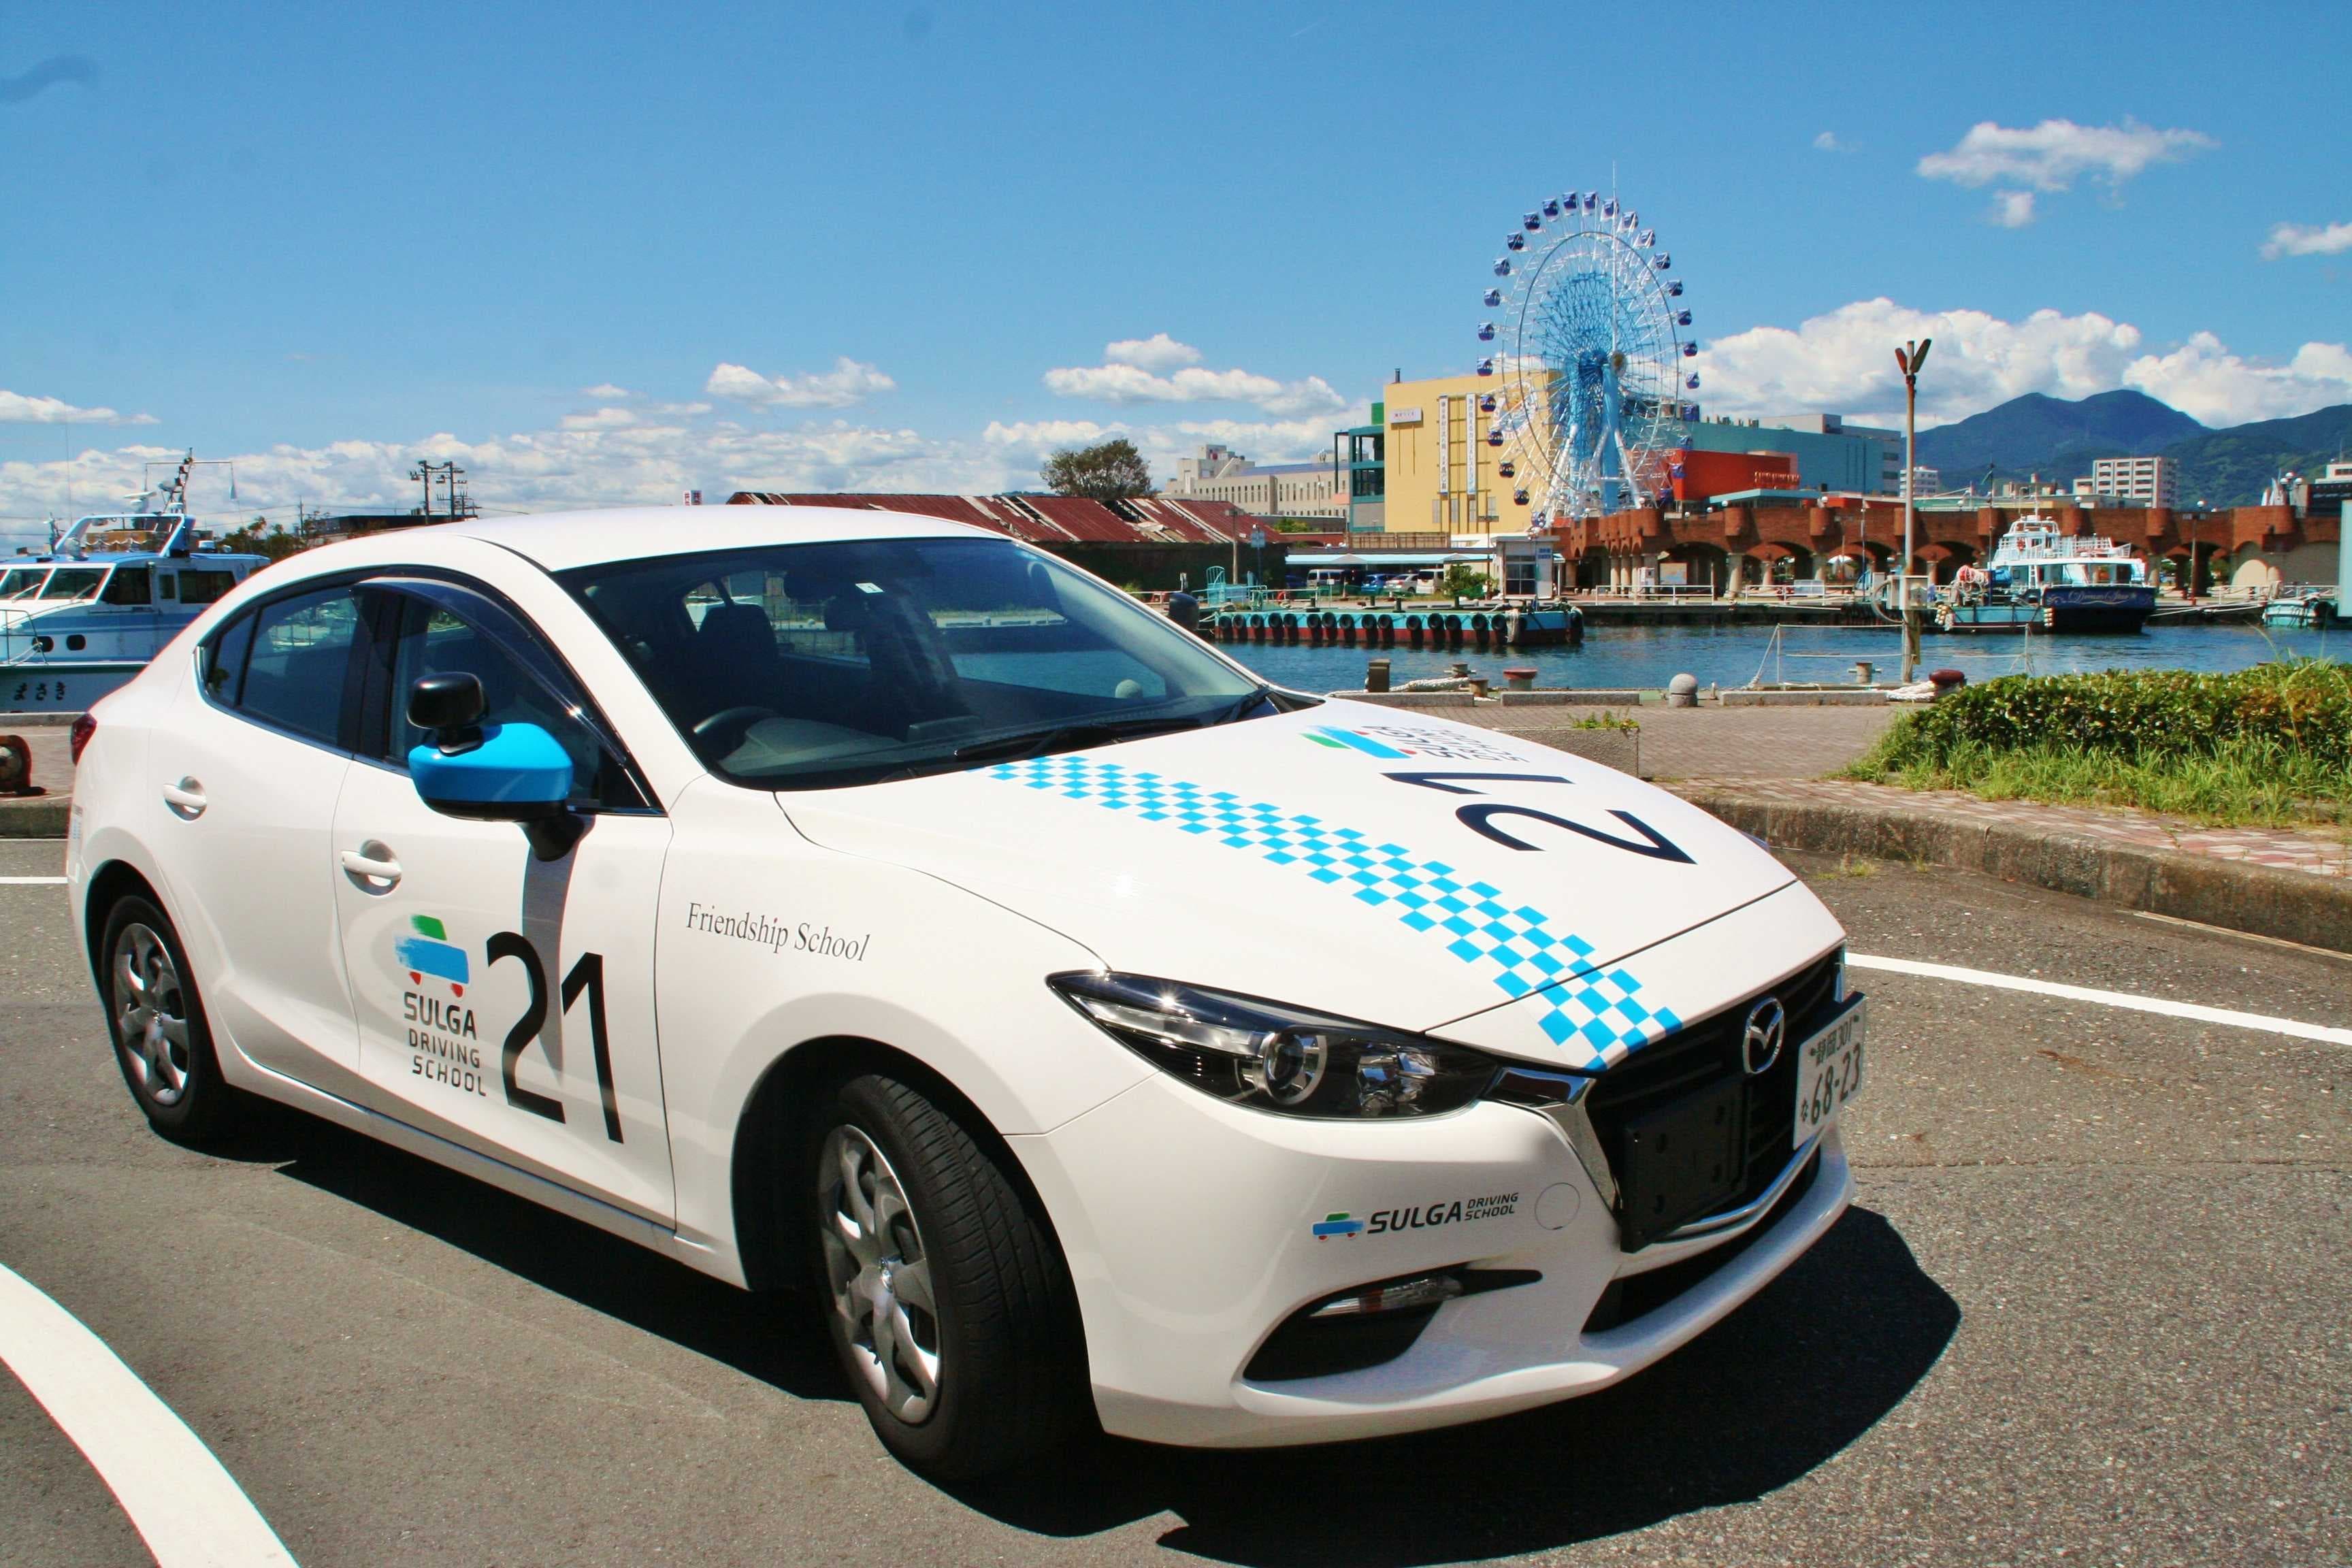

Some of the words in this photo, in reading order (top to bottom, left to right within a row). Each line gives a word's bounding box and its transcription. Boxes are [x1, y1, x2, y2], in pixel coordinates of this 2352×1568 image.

[1361, 725, 1473, 760] SULGA
[1379, 772, 1699, 865] 21
[686, 902, 789, 954] Friendship
[794, 922, 871, 962] School
[404, 992, 477, 1041] SULGA
[486, 931, 624, 1144] 21
[408, 1028, 480, 1069] DRIVING
[412, 1055, 487, 1097] SCHOOL
[1811, 1043, 1861, 1124] 68-23
[1367, 1200, 1462, 1234] SULGA
[1464, 1205, 1515, 1221] SCHOOL
[1467, 1192, 1519, 1209] DRIVING
